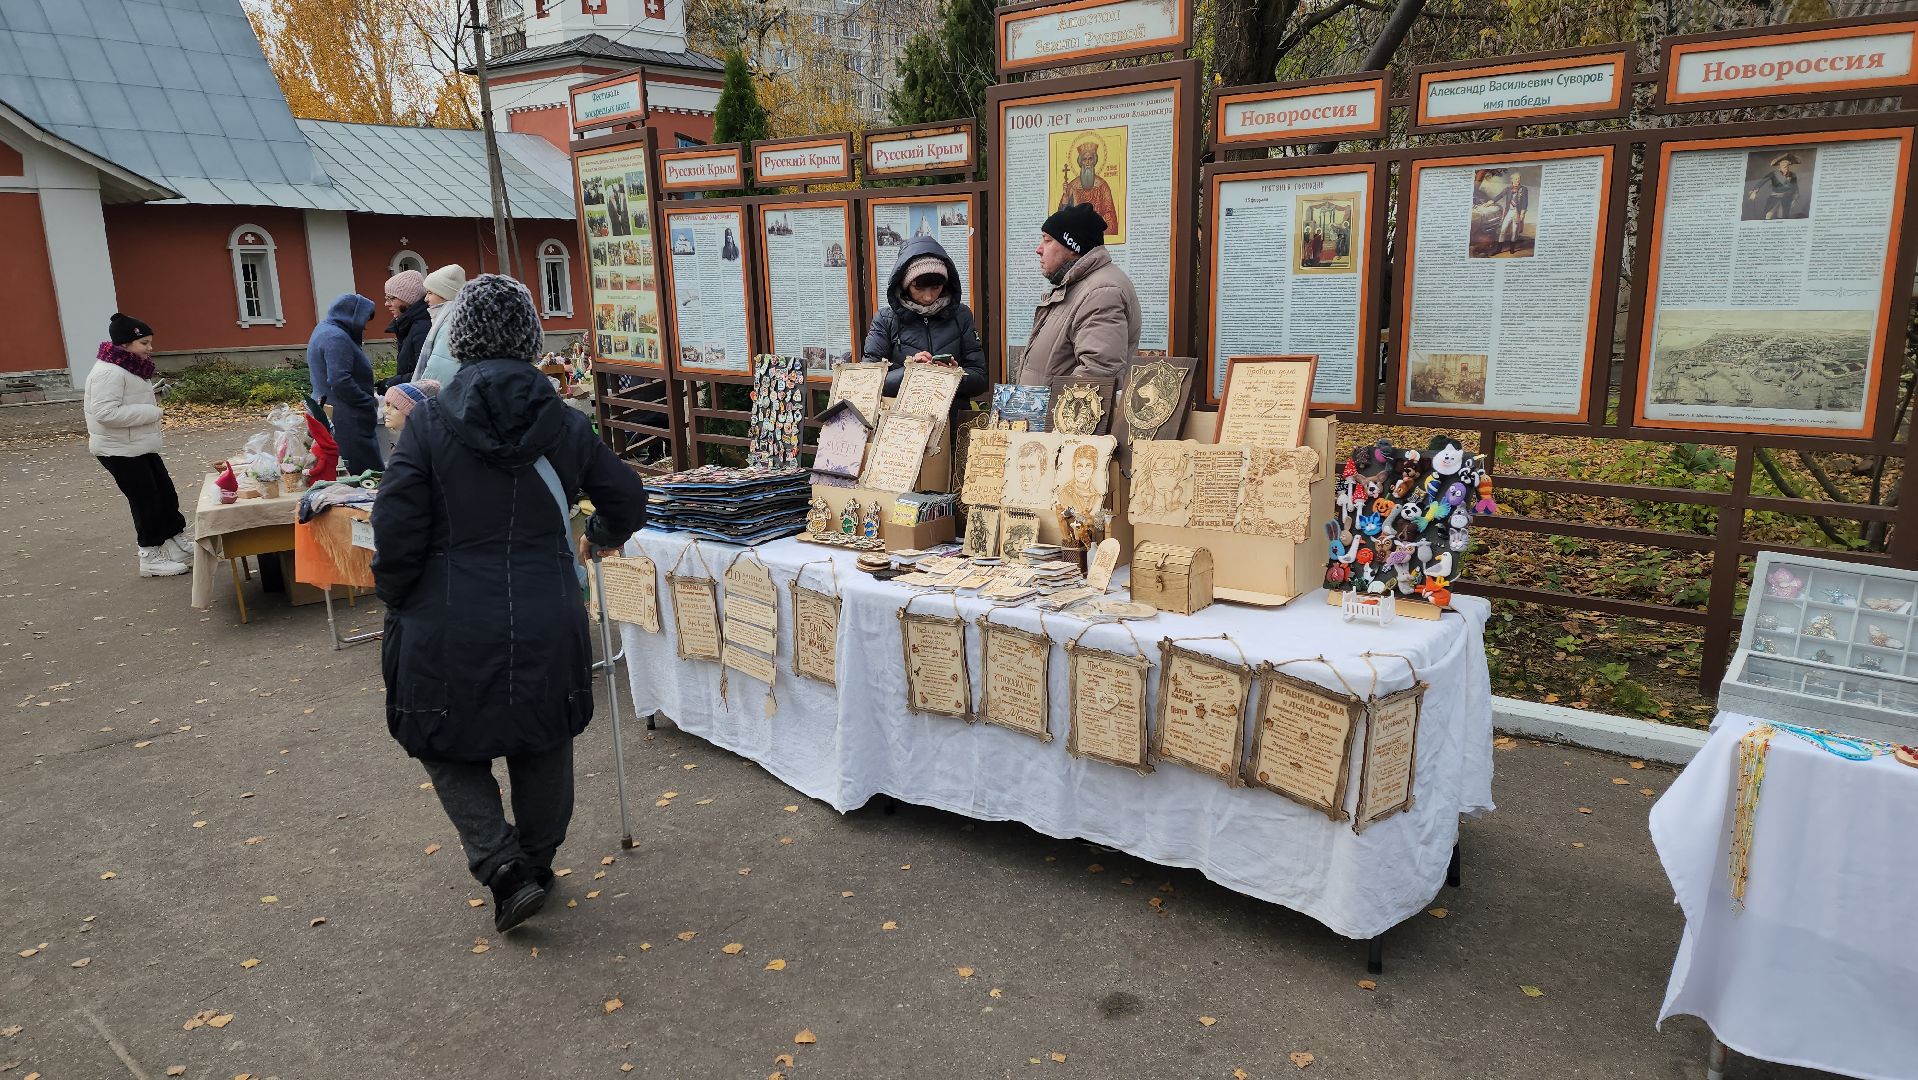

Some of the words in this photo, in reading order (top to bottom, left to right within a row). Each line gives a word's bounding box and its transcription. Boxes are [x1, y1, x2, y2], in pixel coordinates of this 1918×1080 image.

[1035, 37, 1080, 55] Земли
[1084, 24, 1146, 47] Русской
[1701, 52, 1885, 83] Новороссия
[592, 90, 620, 103] Фестиваль
[1430, 84, 1486, 98] Александр
[1489, 77, 1553, 92] Васильевич
[1556, 72, 1604, 87] Суворов
[1483, 99, 1504, 110] имя
[1507, 95, 1551, 108] победы
[1009, 113, 1043, 131] 1000
[1046, 113, 1072, 127] лет
[1240, 104, 1358, 127] Новороссия
[764, 155, 806, 171] Русский
[809, 153, 841, 169] Крым
[876, 145, 924, 165] Русский
[927, 142, 964, 160] Крым
[668, 164, 706, 178] Русский
[707, 162, 736, 177] Крым
[1063, 231, 1081, 254] ЦСКА
[1275, 685, 1316, 706] ПРАВИЛА
[1317, 700, 1345, 716] ДОМА
